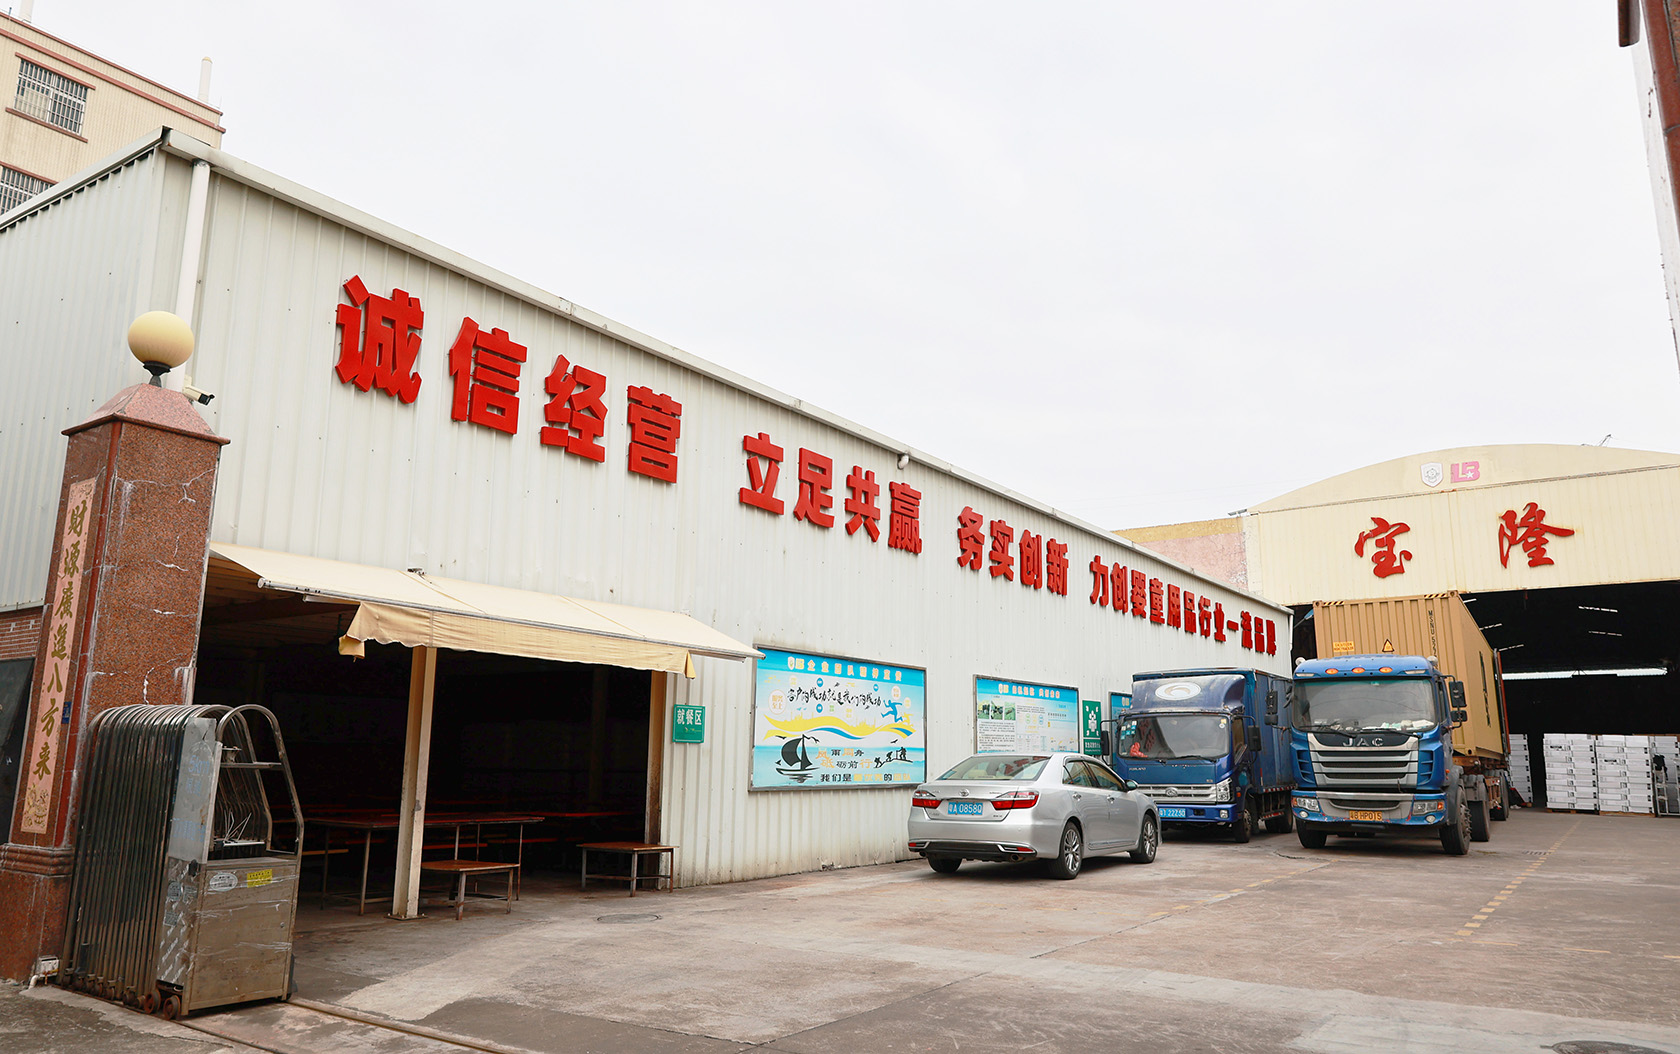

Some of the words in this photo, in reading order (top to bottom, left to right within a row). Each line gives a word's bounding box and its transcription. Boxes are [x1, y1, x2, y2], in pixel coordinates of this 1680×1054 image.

[335, 275, 682, 484] 诚信经营
[739, 432, 922, 554] 立足共赢
[957, 506, 1068, 596] 务实创新
[677, 709, 702, 725] 就餐区
[1342, 737, 1384, 747] JAC
